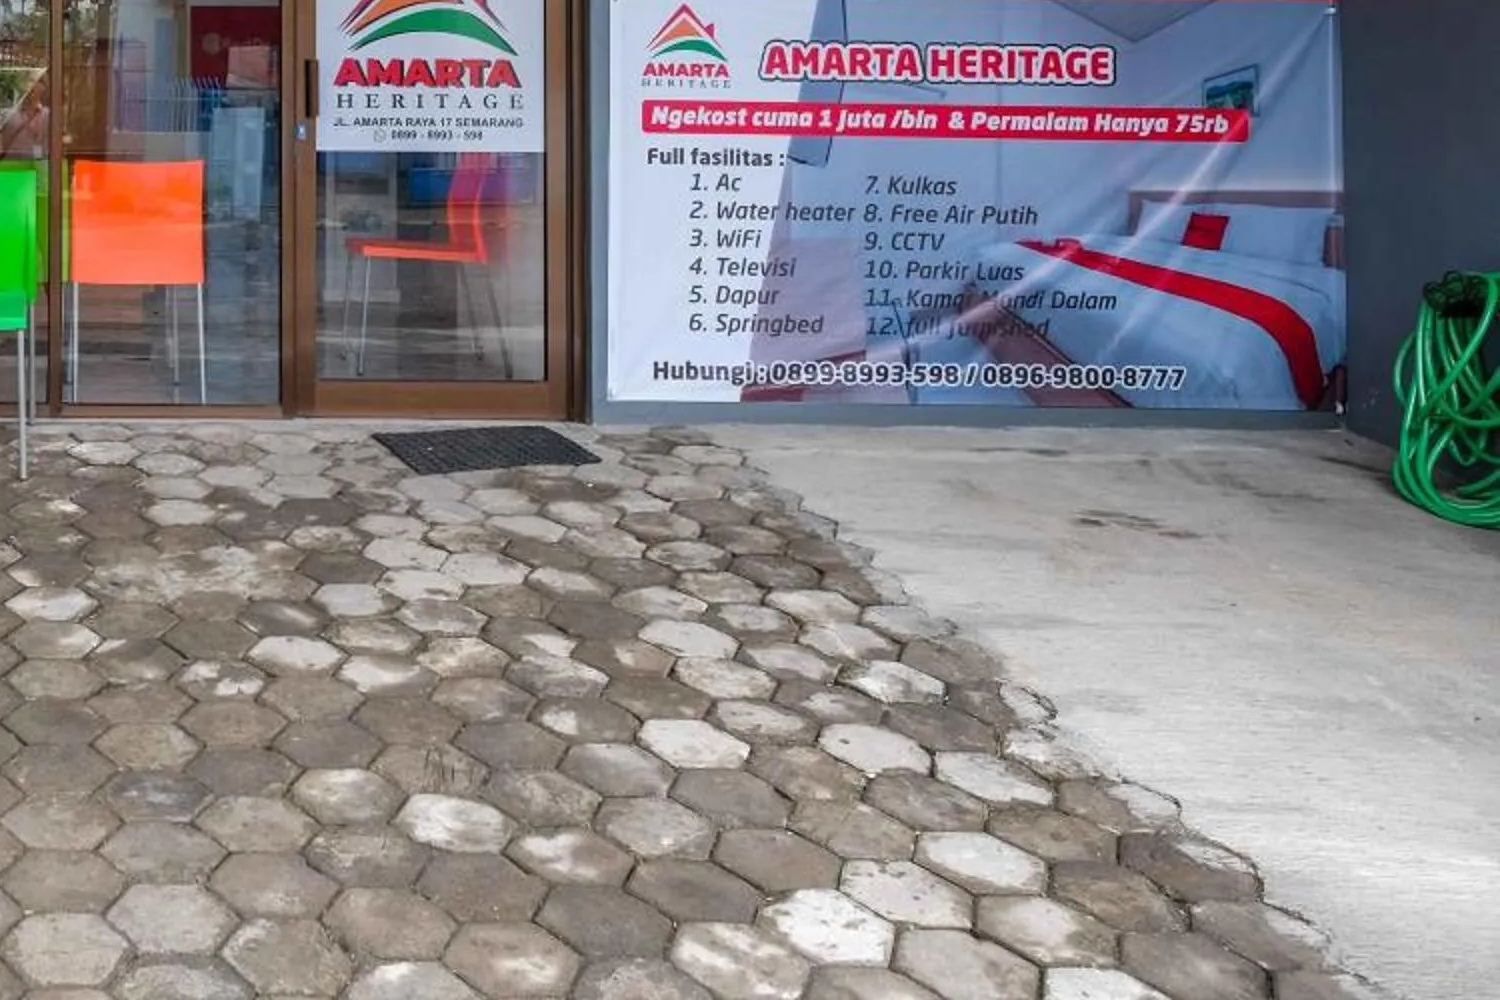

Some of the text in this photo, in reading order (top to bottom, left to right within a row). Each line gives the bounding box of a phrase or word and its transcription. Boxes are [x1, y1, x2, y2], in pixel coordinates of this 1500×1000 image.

[333, 58, 522, 88] AMARTA
[643, 62, 730, 78] AMARTA
[763, 45, 1110, 81] AMARTA HERITAGE
[336, 93, 525, 110] HERITAGE
[353, 117, 402, 127] AMARTA
[405, 117, 437, 127] RAYA
[440, 117, 451, 127] 17
[455, 117, 524, 128] SEMARANG
[651, 106, 747, 128] Ngekost
[752, 112, 813, 126] cuma
[818, 110, 832, 126] 1
[948, 112, 964, 129] &
[971, 111, 1088, 132] Permalam
[1094, 113, 1168, 137] Hanya
[1175, 114, 1229, 133] 75rb
[647, 148, 684, 165] Full
[691, 148, 773, 166] fasilitas
[690, 173, 741, 191] 1. Ac
[865, 176, 957, 195] 7. Kulkas
[689, 201, 855, 221] 2. Water heater
[863, 204, 1039, 225] 8. Free Air Putih
[689, 229, 762, 248] 3. WiFi
[864, 232, 945, 251] 9. CCTV
[689, 257, 797, 277] 4. Televisi
[864, 260, 1025, 281] 10. Parkir Luas
[689, 285, 781, 308] 5. Dapur
[1051, 290, 1116, 310] Dalam
[689, 313, 824, 336] 6. Springbed
[866, 317, 897, 336] 12.
[653, 361, 750, 385] Hubungi
[771, 362, 958, 384] 0899-8993-598
[982, 364, 1184, 388] 0896-9800-8777
